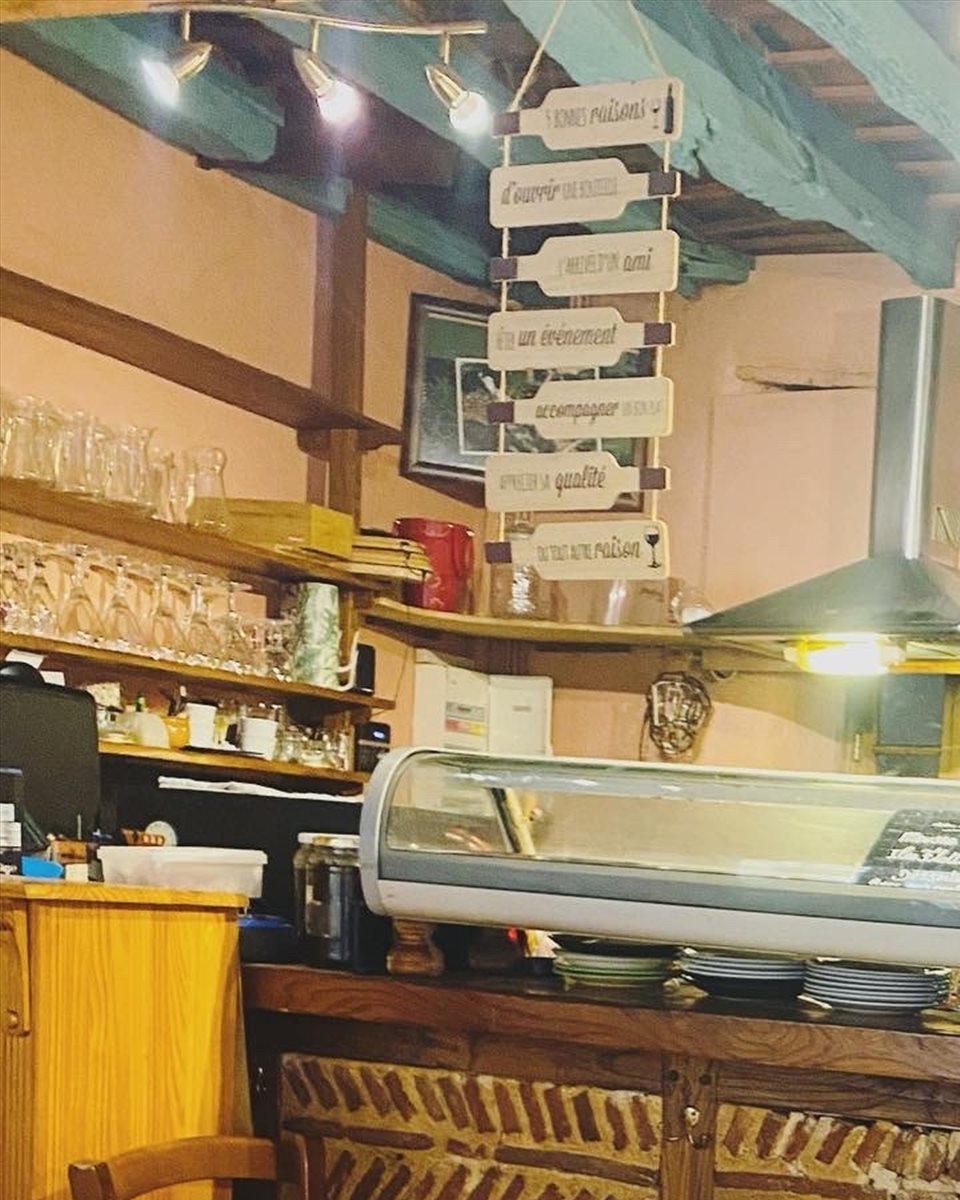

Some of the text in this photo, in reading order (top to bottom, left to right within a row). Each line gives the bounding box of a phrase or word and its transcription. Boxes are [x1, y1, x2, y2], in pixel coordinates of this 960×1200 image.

[589, 98, 646, 124] raisons
[623, 247, 653, 271] ami
[518, 329, 537, 346] un
[535, 402, 619, 425] accompagner
[554, 464, 606, 498] qualité
[594, 536, 640, 559] raison
